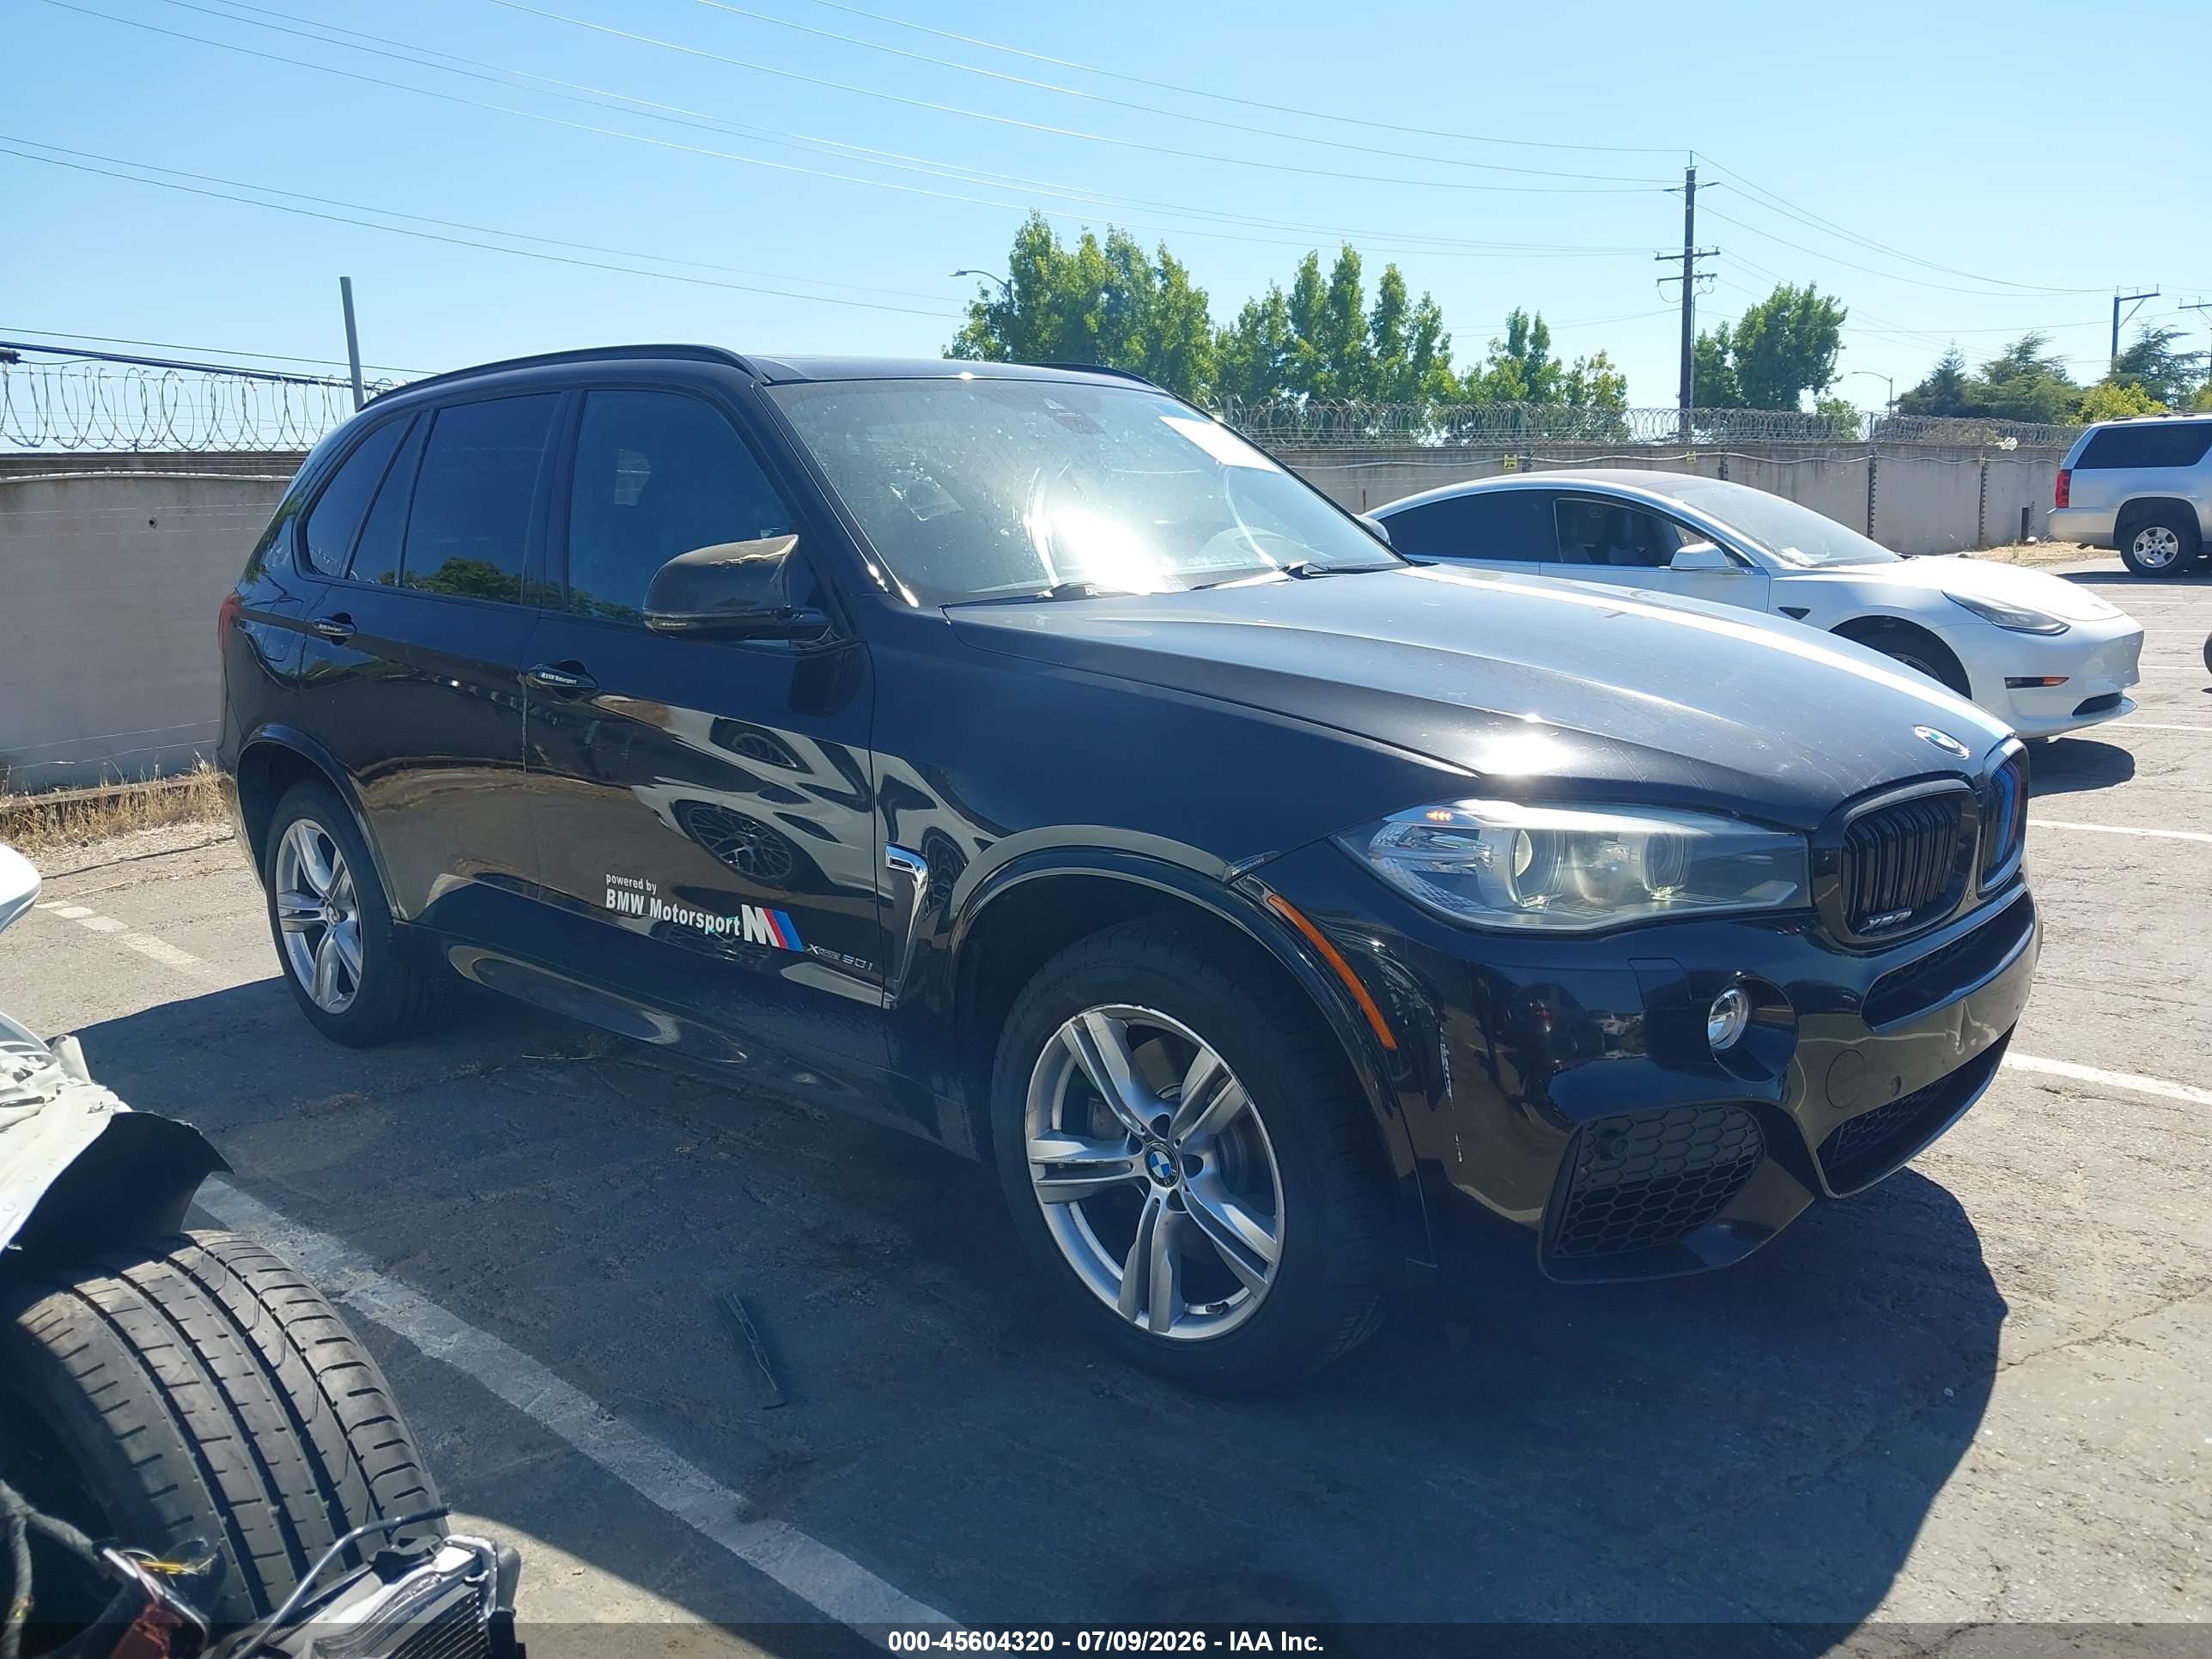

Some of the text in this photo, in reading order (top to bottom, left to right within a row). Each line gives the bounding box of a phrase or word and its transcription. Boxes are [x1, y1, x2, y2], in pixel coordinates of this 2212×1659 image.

[605, 873, 657, 894] powered by
[605, 888, 644, 915] BMW
[649, 897, 740, 936] Motorsport
